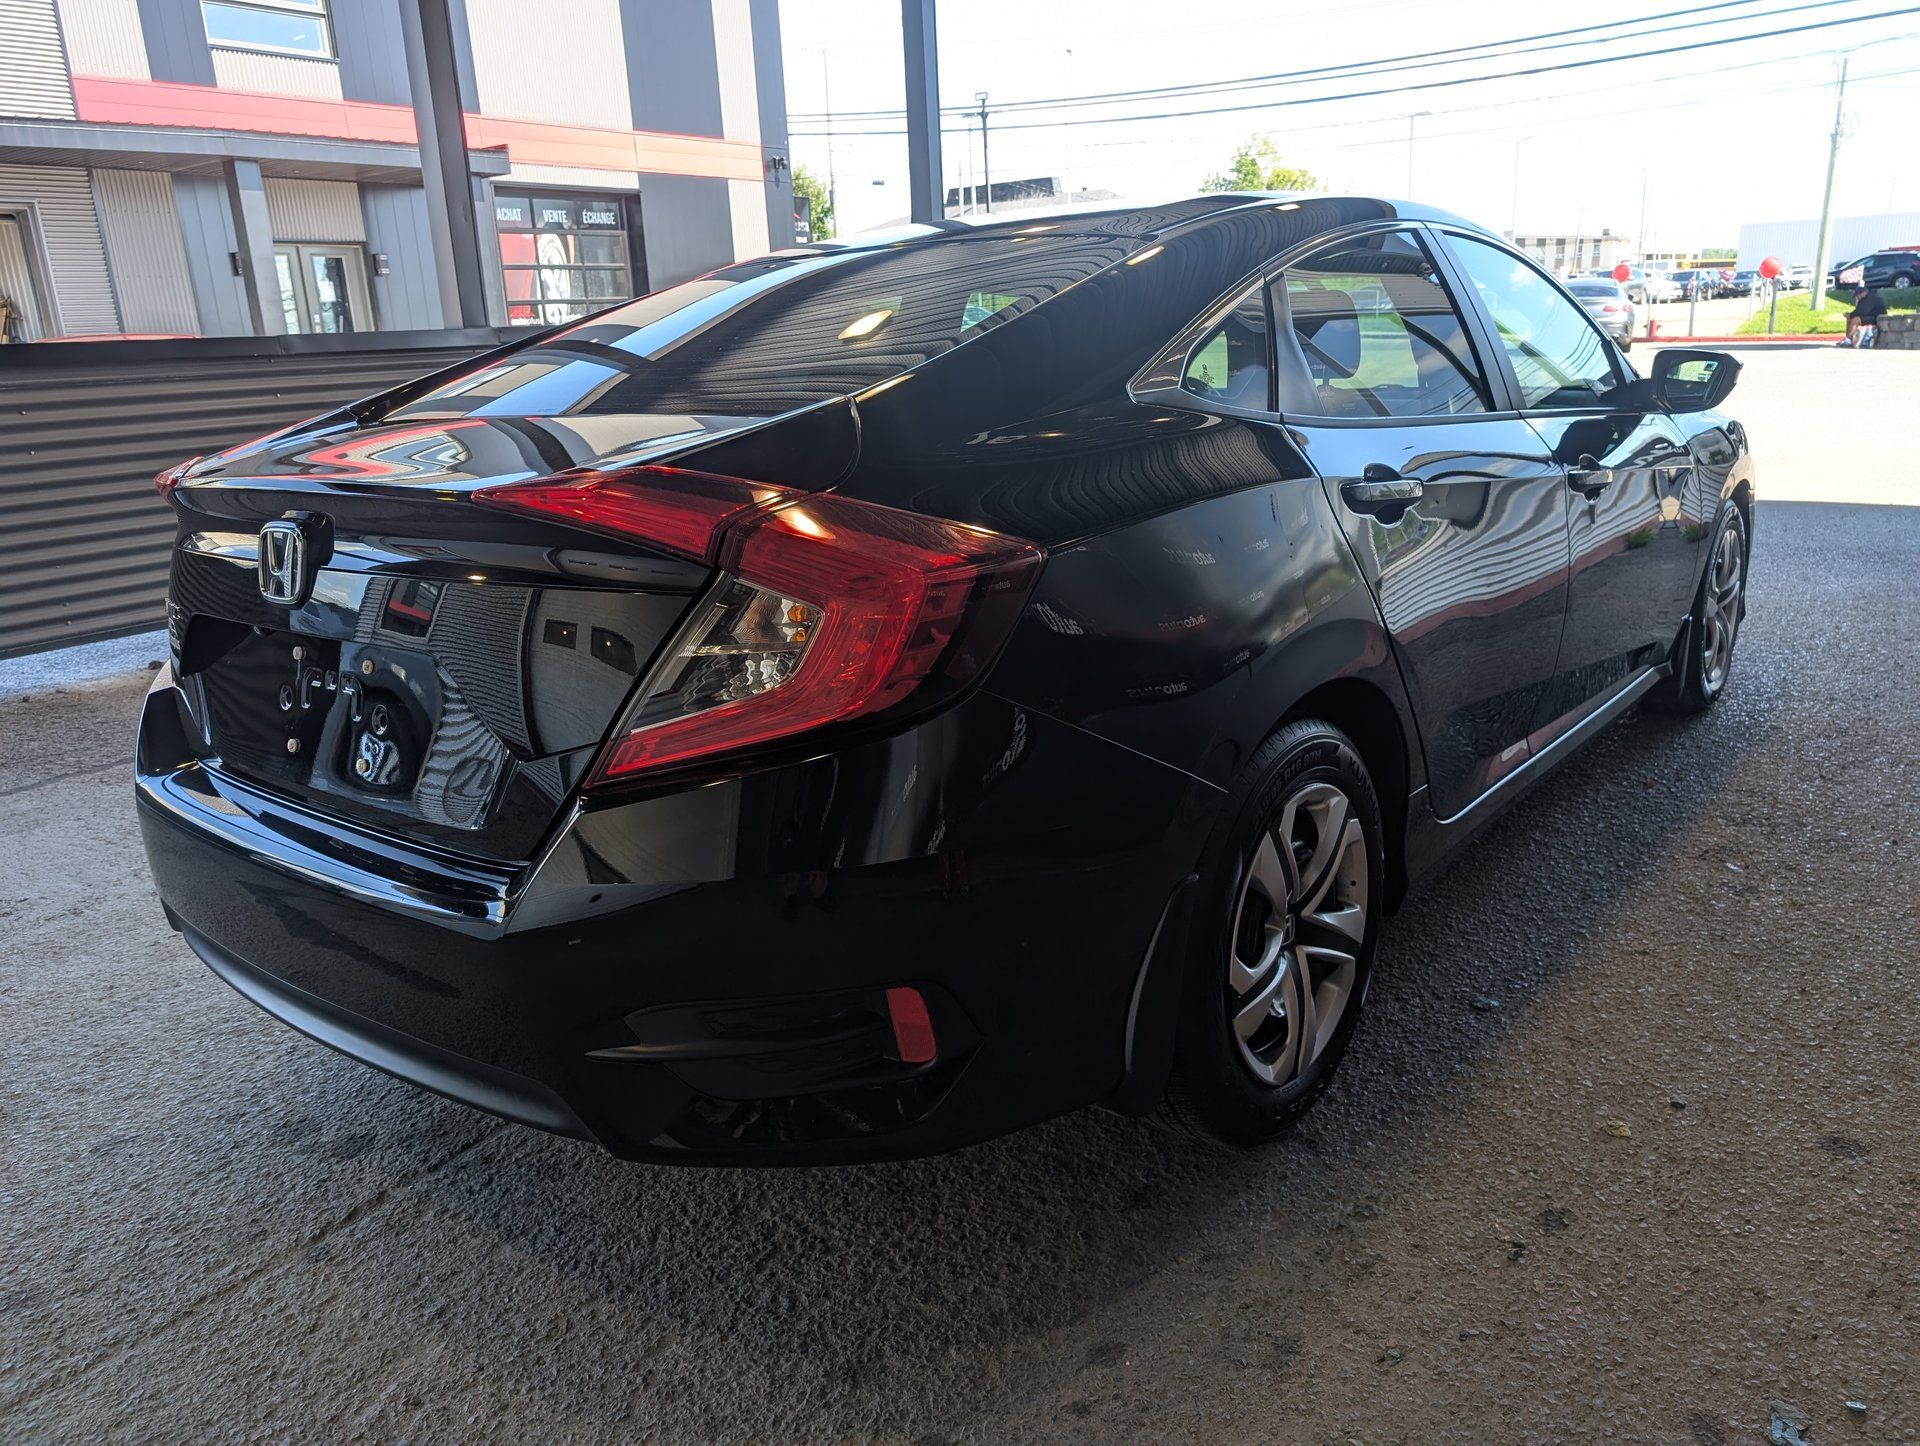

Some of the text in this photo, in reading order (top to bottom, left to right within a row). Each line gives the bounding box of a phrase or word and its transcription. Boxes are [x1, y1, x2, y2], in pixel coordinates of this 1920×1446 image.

[496, 208, 616, 225] ACHAT VENTE ÉCHANGE
